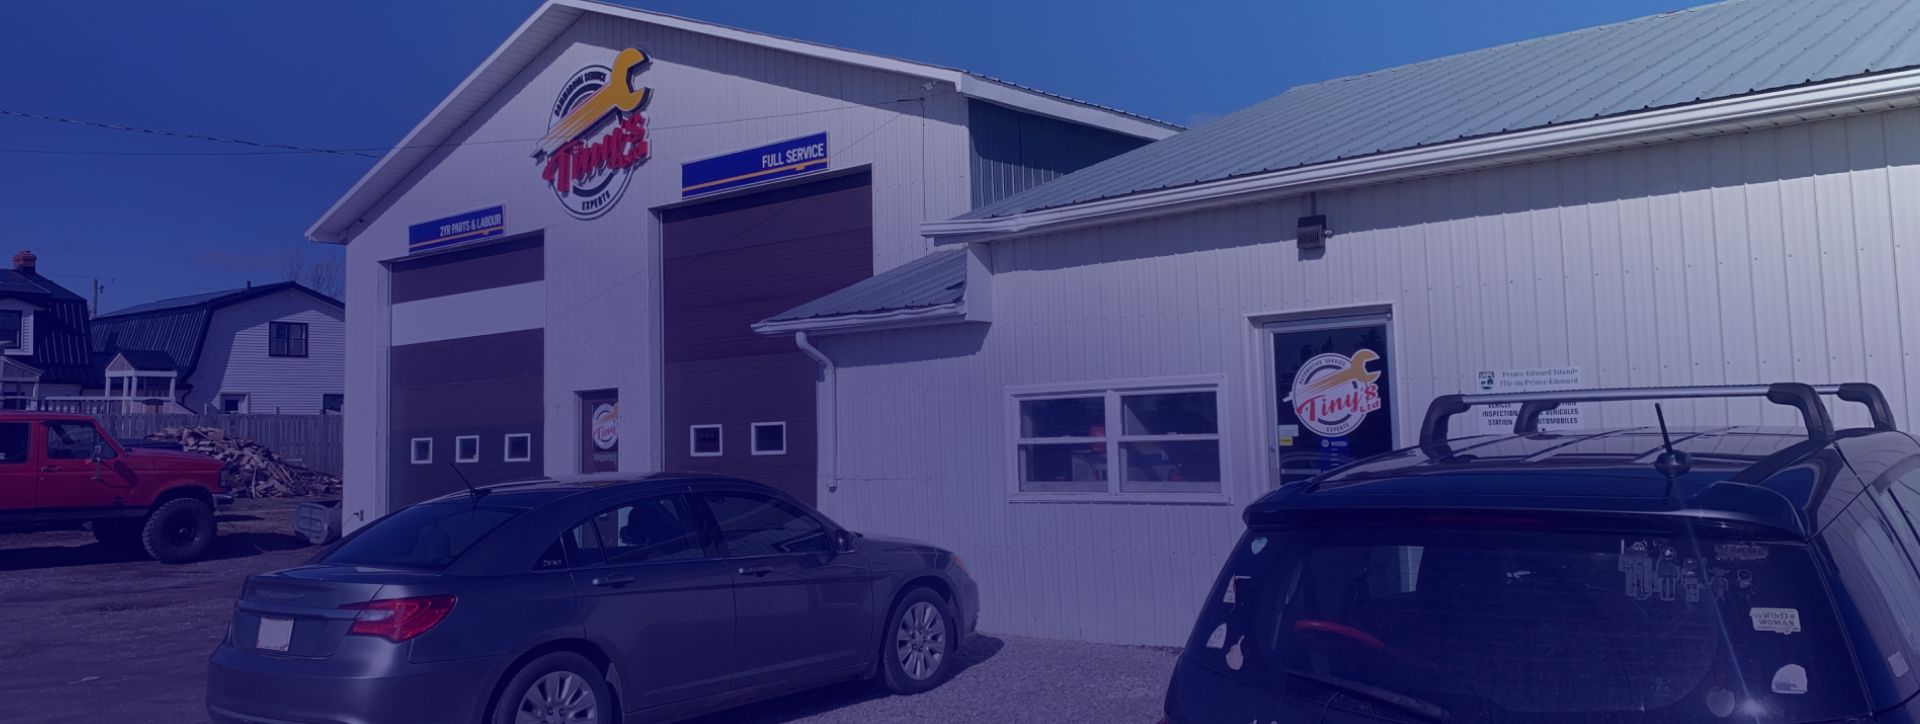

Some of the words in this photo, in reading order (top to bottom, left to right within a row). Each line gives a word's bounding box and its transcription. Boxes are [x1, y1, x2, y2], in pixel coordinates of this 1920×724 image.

[584, 71, 607, 83] SERVICE
[543, 113, 646, 192] Tiny's
[762, 152, 784, 169] FULL
[786, 143, 825, 163] SERVICE
[582, 190, 611, 211] EXPERTS
[440, 225, 451, 237] 2YR
[452, 220, 470, 234] PARTS
[471, 219, 476, 230] &
[477, 214, 502, 229] LABOUR
[1325, 359, 1346, 367] SERVICE
[1296, 384, 1378, 421] Tiny's
[1360, 400, 1380, 413] Ltd
[1327, 423, 1349, 432] EXPERTS
